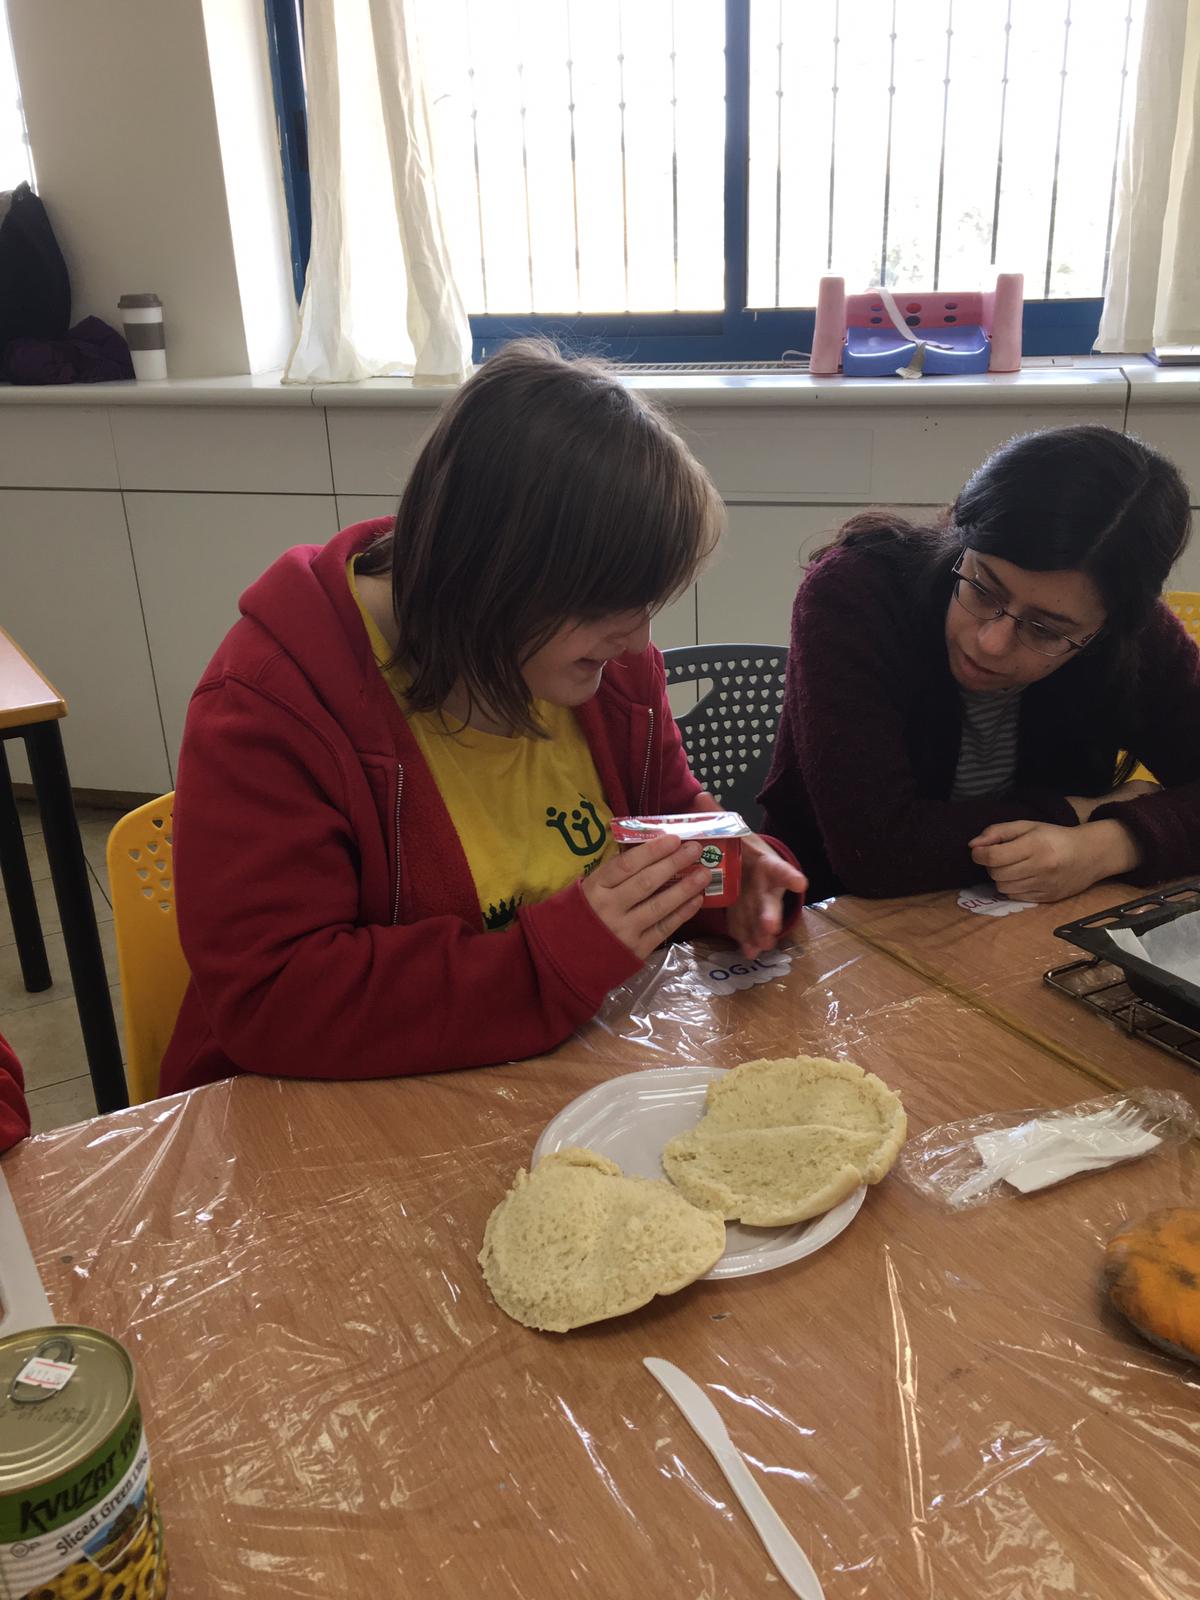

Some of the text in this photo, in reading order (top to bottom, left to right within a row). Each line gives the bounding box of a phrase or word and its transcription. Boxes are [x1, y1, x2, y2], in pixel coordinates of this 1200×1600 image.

[20, 1449, 116, 1534] KVUZAT
[55, 1478, 134, 1556] Sliced Green
